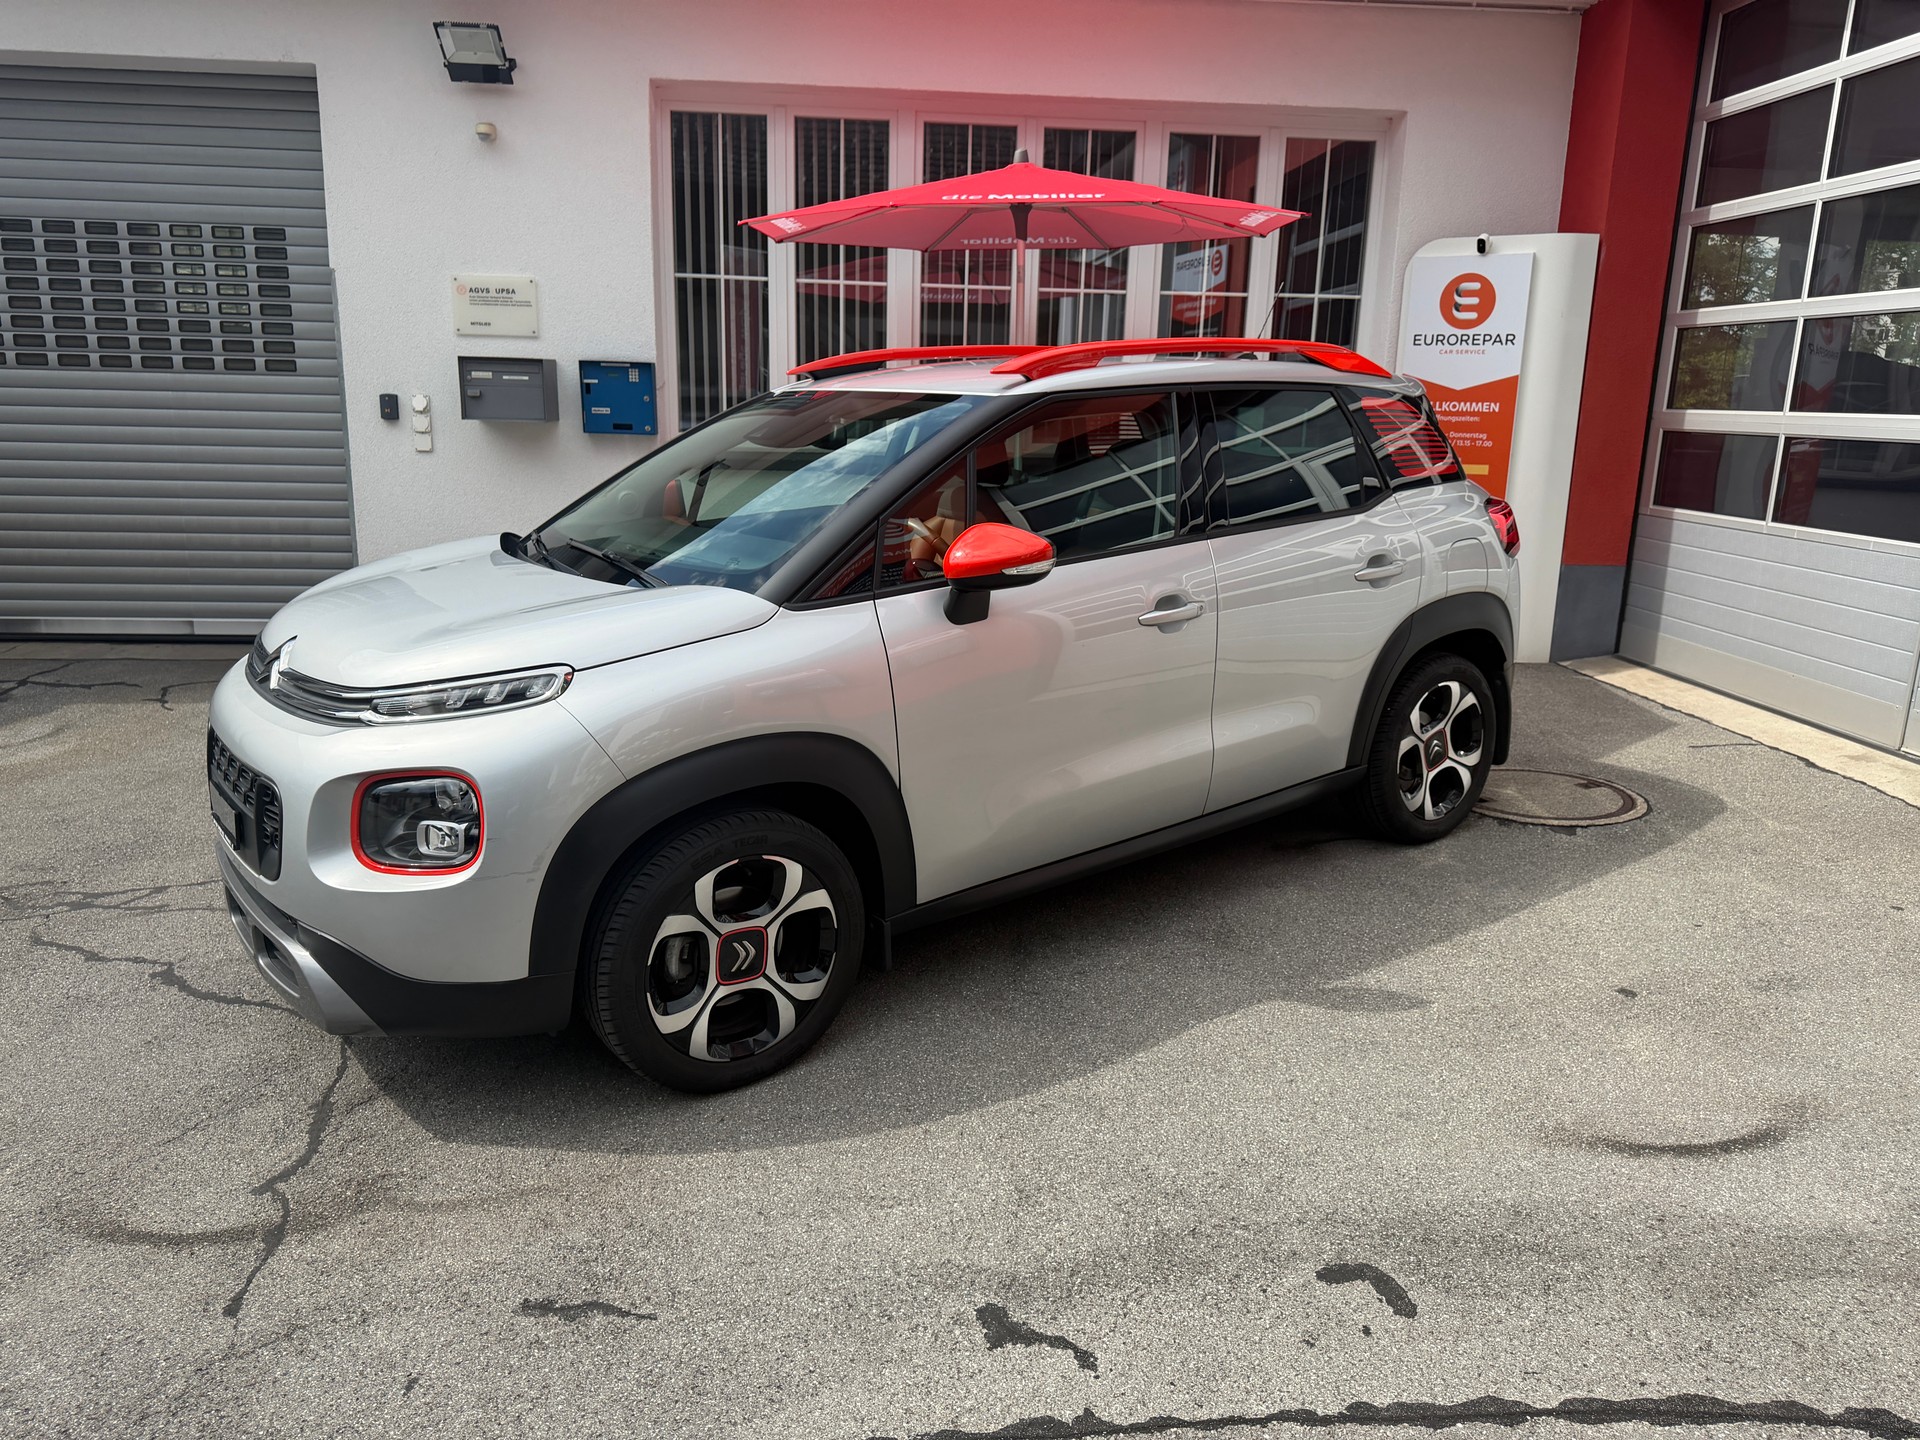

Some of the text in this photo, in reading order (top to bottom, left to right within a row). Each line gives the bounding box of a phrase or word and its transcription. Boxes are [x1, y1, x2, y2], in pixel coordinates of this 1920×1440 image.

[1412, 333, 1516, 346] EUROREPAR
[1430, 401, 1500, 412] LKOMMEN
[1449, 431, 1487, 440] Donnerstag
